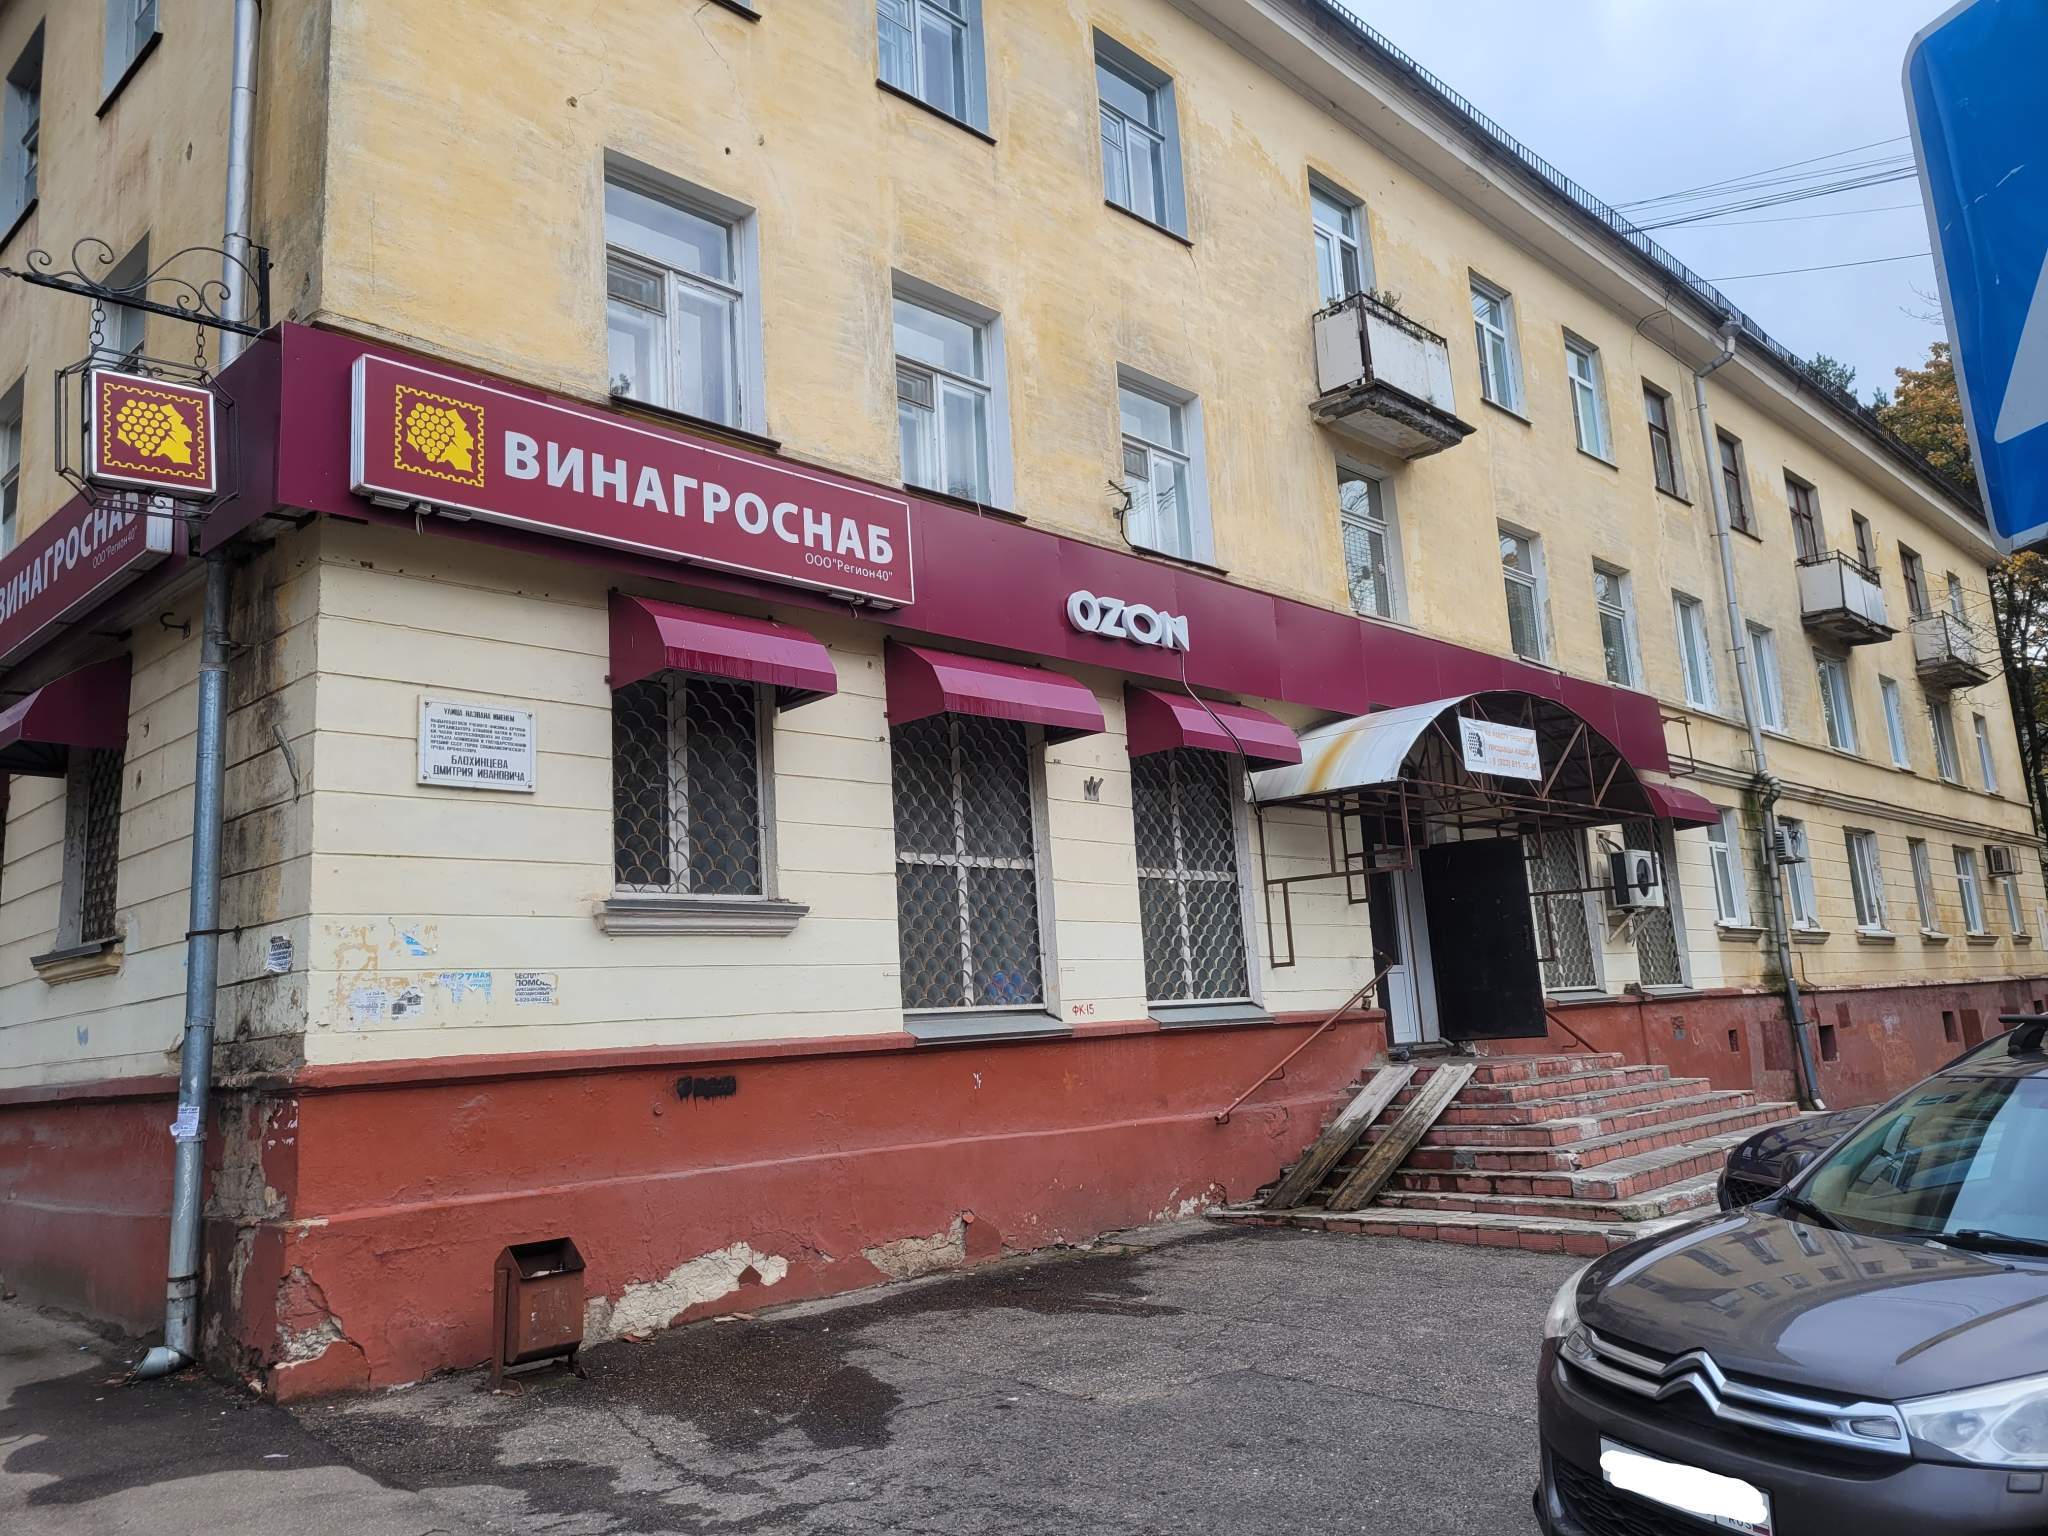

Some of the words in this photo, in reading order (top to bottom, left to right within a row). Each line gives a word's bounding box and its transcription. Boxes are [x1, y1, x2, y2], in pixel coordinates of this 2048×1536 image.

[505, 430, 893, 565] ВИНАГРОСНАБ
[1067, 590, 1190, 652] OZON
[443, 707, 462, 716] УЛИЦА
[465, 710, 491, 719] НАЗВАНА
[493, 713, 514, 722] ИМЕНЕМ
[451, 755, 509, 769] БЛОХИНЦЕВА
[433, 765, 474, 778] ДМИТРИЯ
[477, 768, 526, 782] ИВАНОВИЧА
